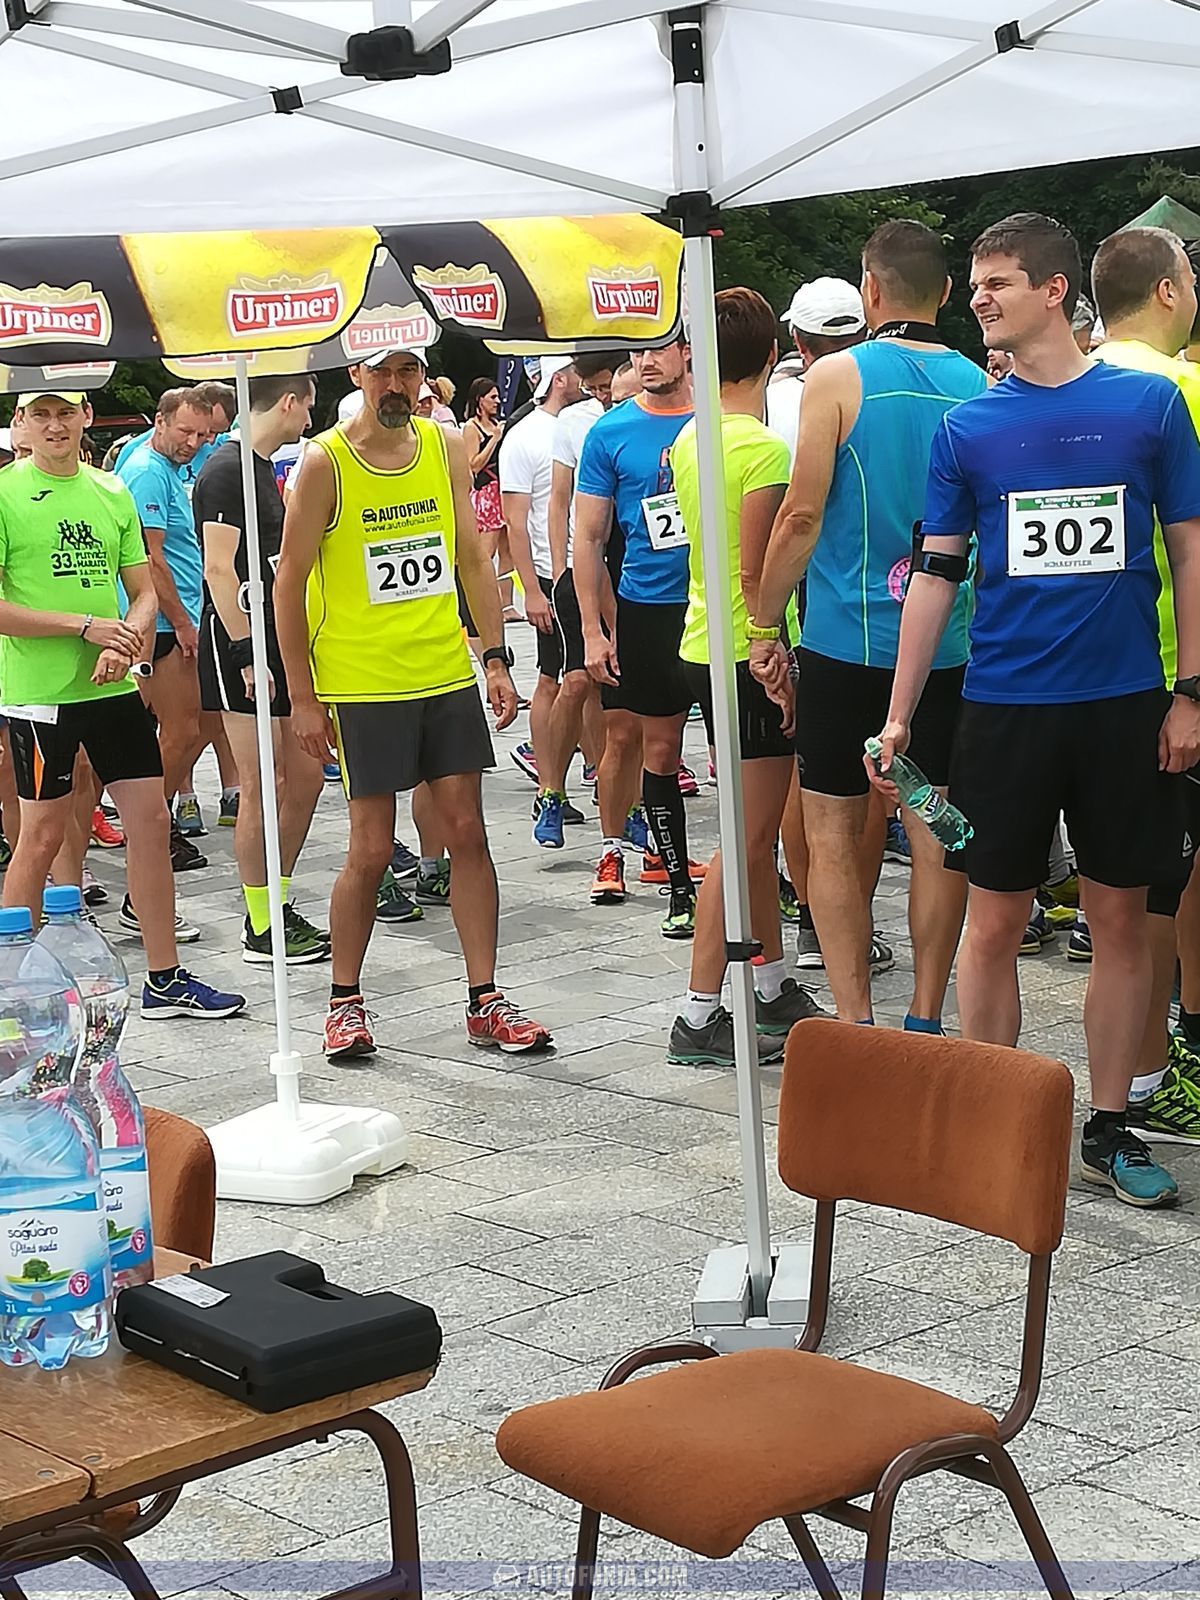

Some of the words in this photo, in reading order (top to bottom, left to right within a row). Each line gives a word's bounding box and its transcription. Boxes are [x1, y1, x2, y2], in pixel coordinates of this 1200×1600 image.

[234, 295, 335, 328] Urpiner
[594, 284, 657, 313] Urpiner
[0, 304, 97, 333] Urpiner
[364, 514, 441, 533] www.autofunia.com
[379, 498, 438, 522] AUTOFUNIA
[656, 511, 686, 538] 2
[1023, 517, 1115, 557] 302
[51, 553, 77, 569] 33.
[377, 555, 442, 591] 209
[8, 1226, 59, 1240] saguaro
